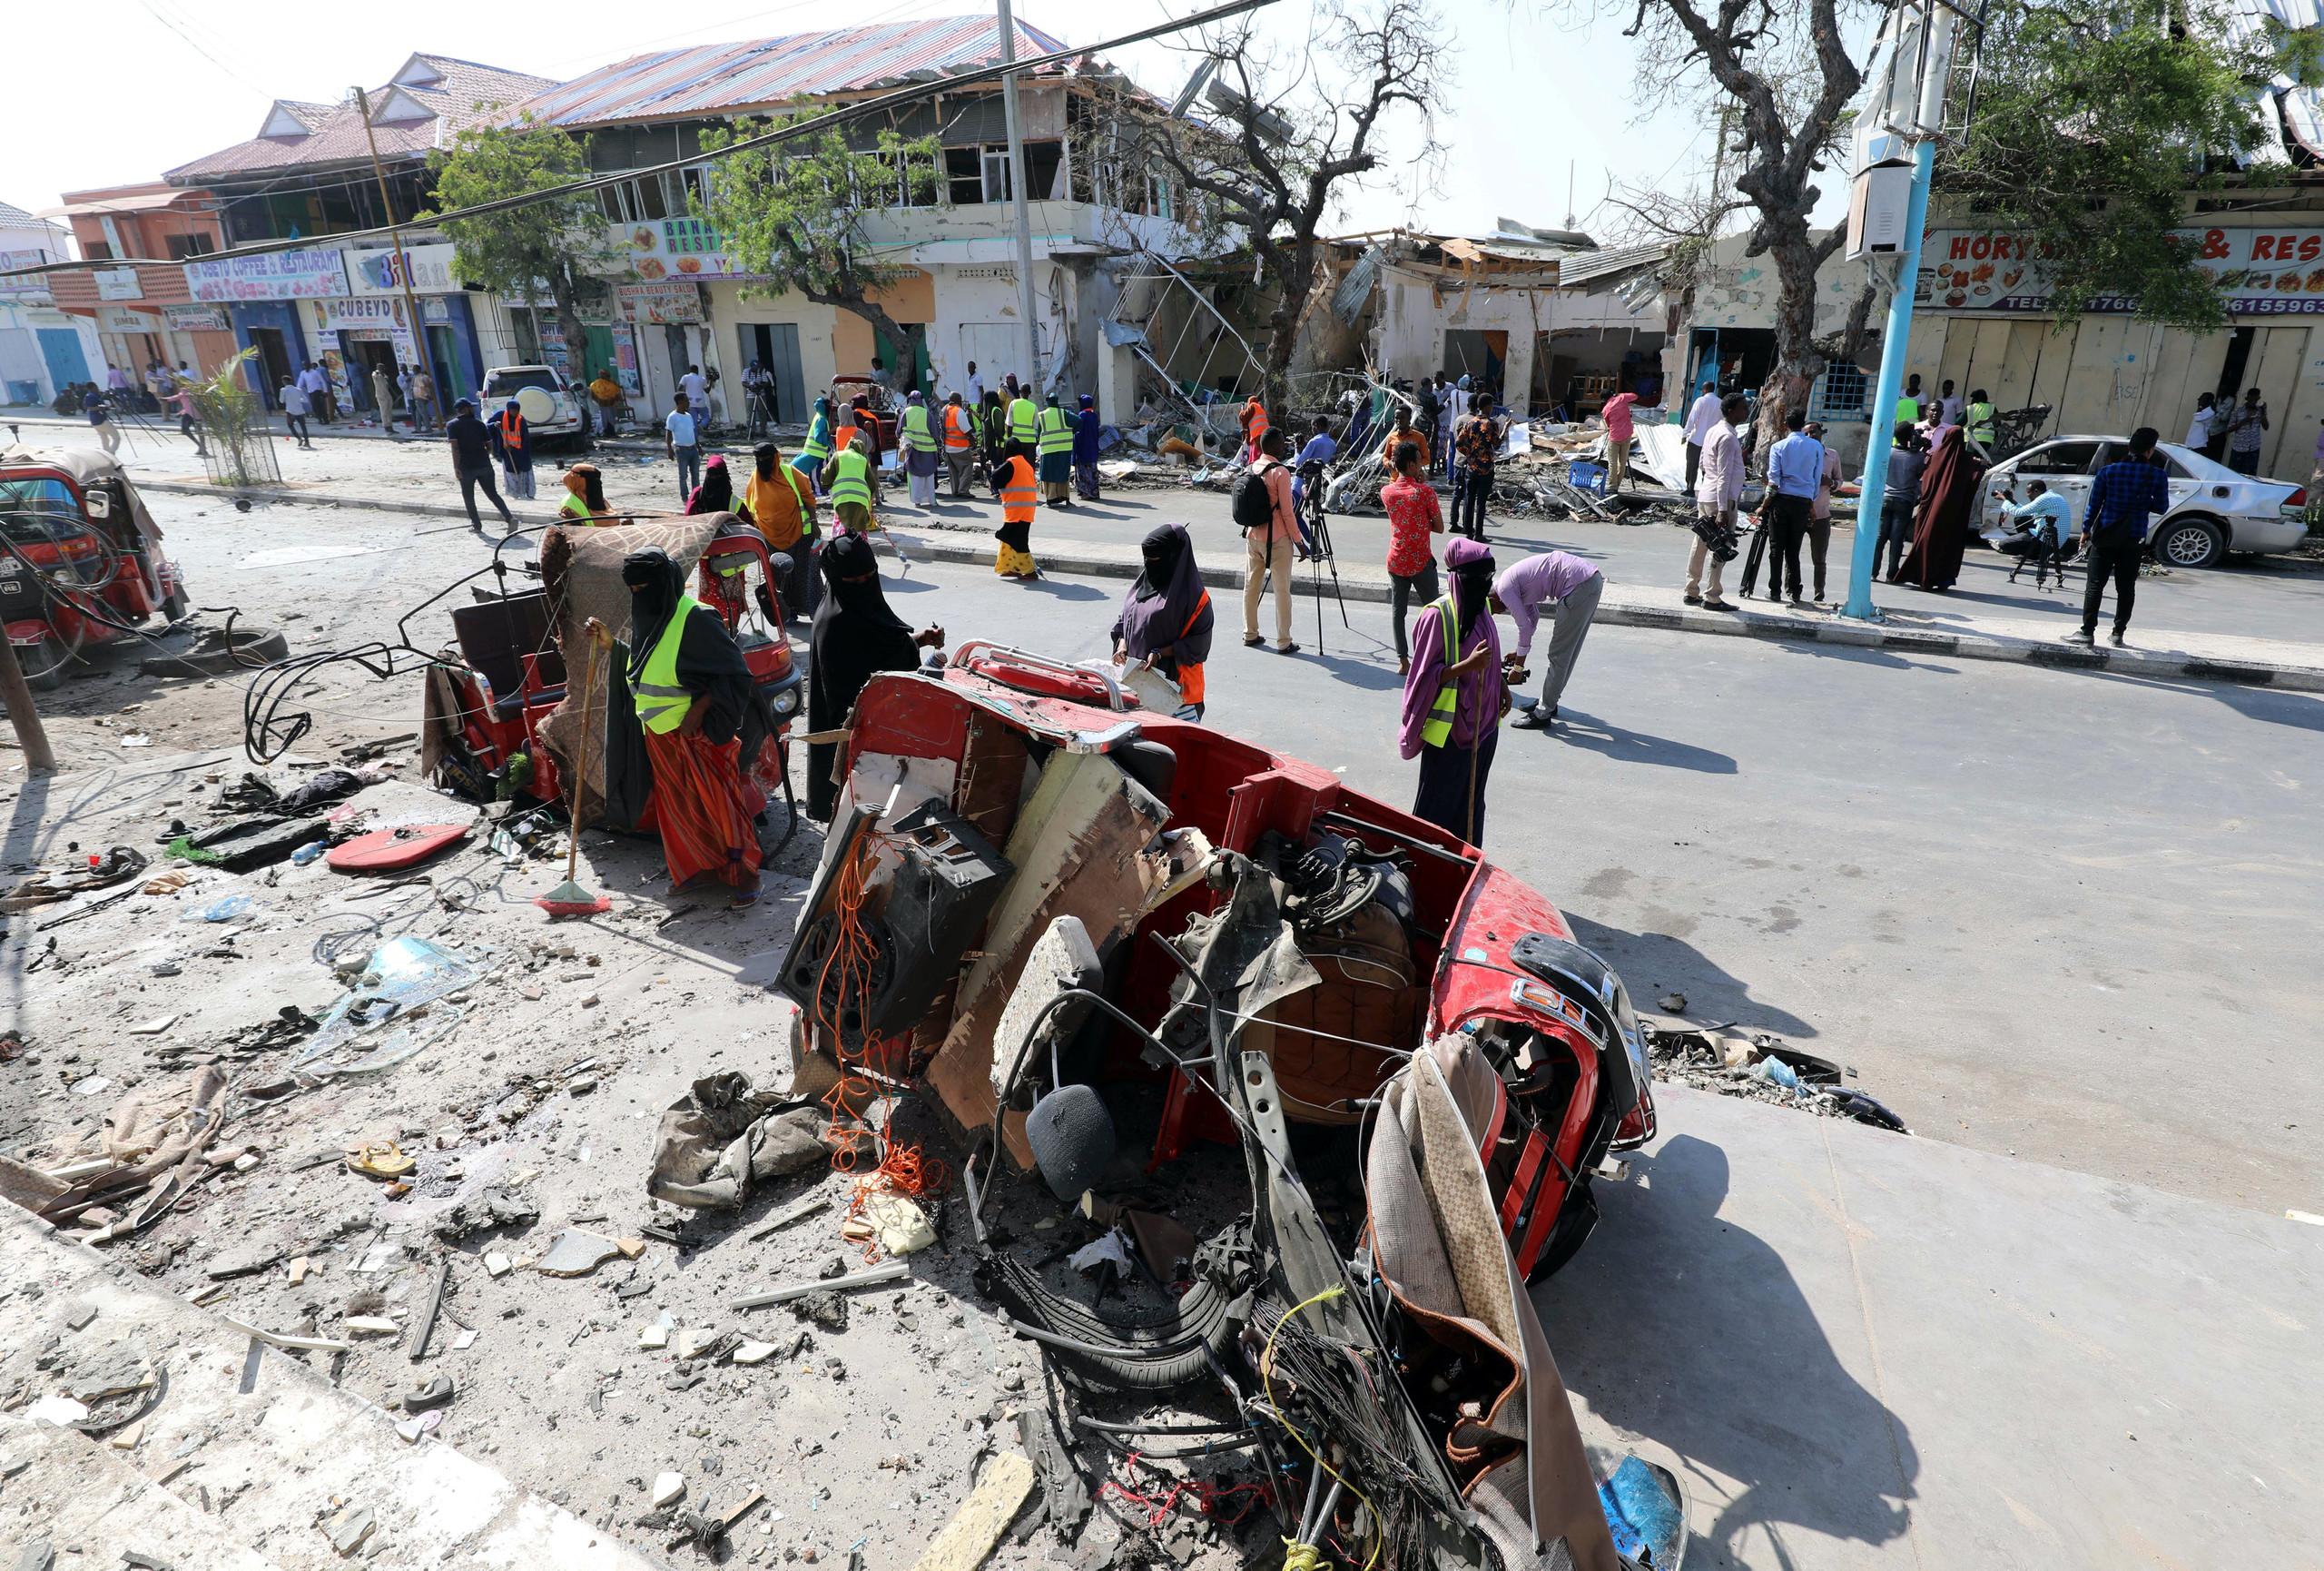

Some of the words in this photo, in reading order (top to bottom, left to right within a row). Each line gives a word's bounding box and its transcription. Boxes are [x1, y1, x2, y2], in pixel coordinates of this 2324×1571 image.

[665, 221, 714, 236] BANA
[668, 234, 725, 253] REST
[2201, 229, 2230, 260] &
[2251, 235, 2321, 261] RES
[280, 250, 340, 274] RESTAURANT
[618, 285, 645, 296] BUSHRA
[645, 285, 672, 295] BEAUTY
[674, 284, 696, 294] SALON
[339, 299, 390, 317] CUBEYD
[113, 317, 142, 326] SIMBA
